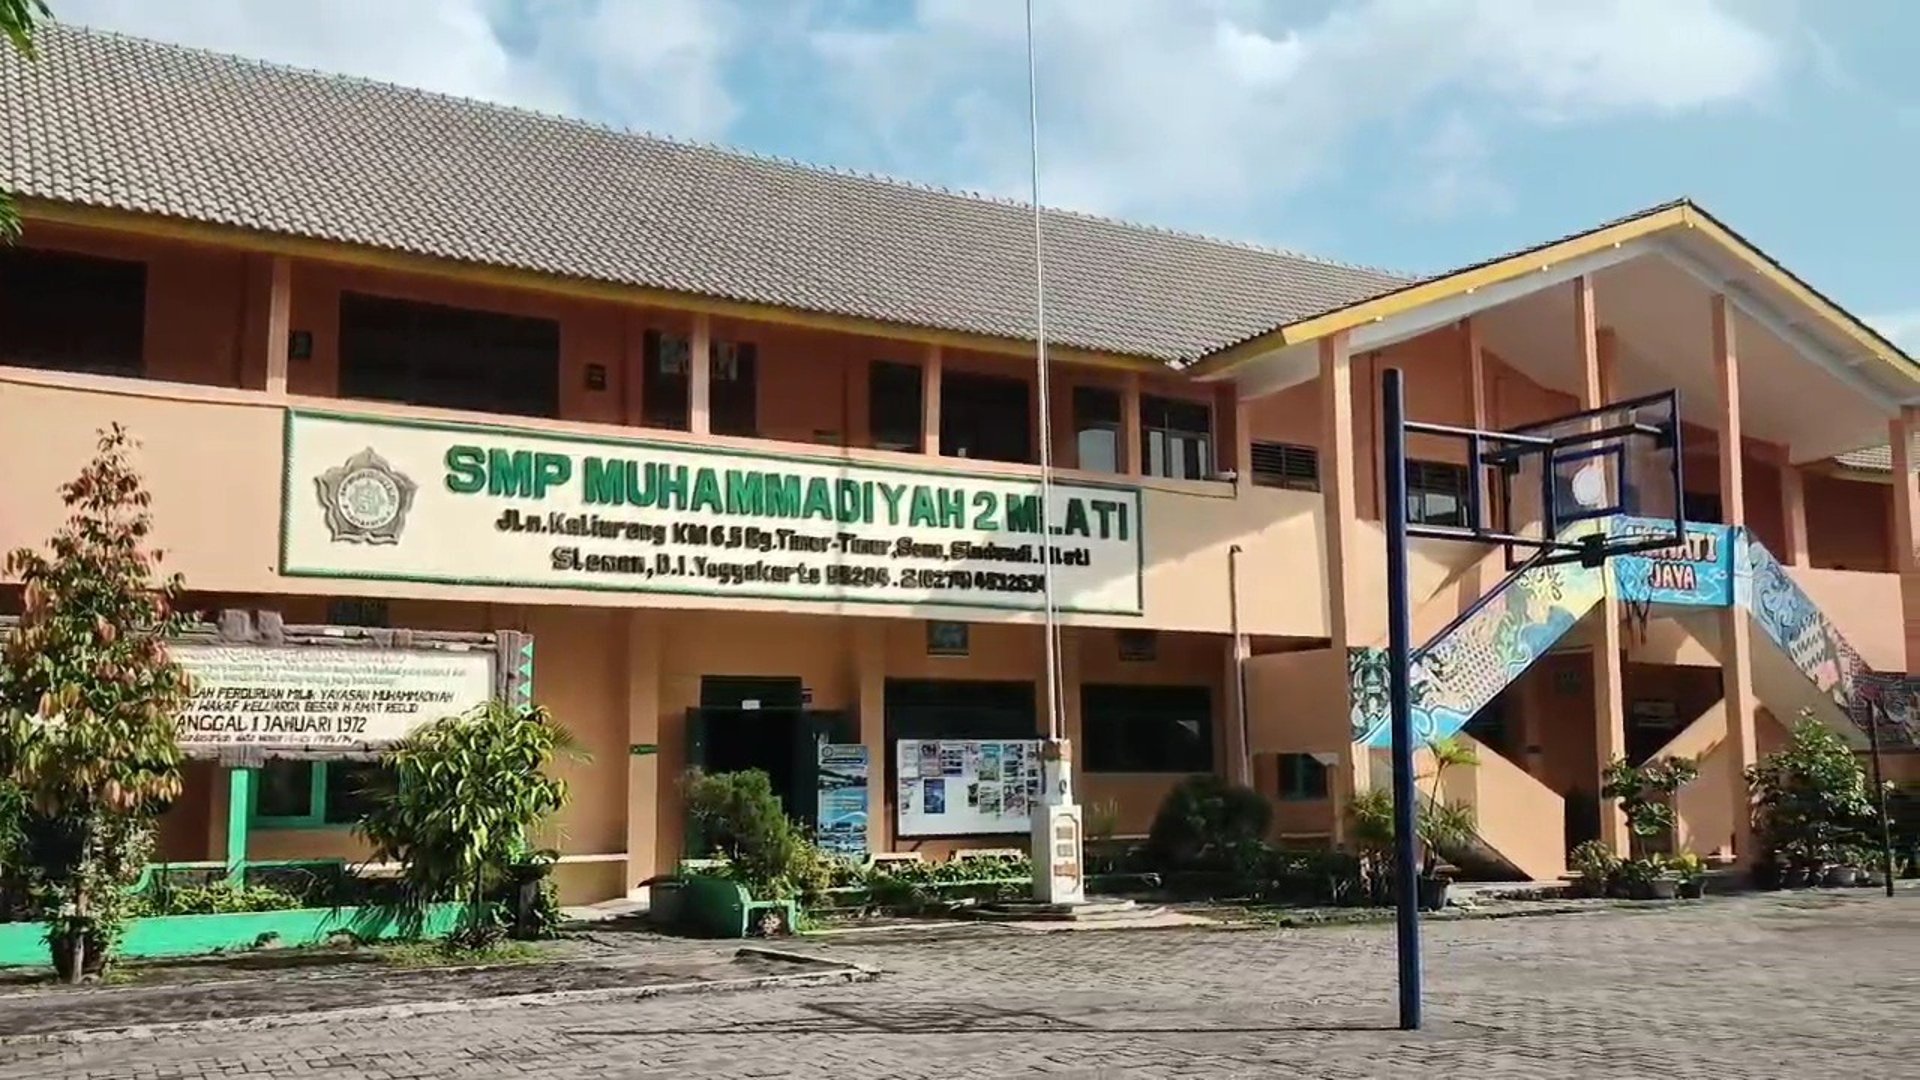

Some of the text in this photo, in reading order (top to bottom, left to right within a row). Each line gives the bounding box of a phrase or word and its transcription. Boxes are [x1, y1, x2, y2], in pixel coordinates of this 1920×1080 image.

[444, 445, 1128, 541] SMP MUHAMMADIYAH 2 MLATI
[1648, 562, 1696, 591] JAYA
[319, 688, 370, 701] YAYASAN
[198, 700, 239, 712] WAKAF
[303, 701, 340, 714] BESAR
[174, 713, 368, 734] ANGGAL 1 JANUARI 1972
